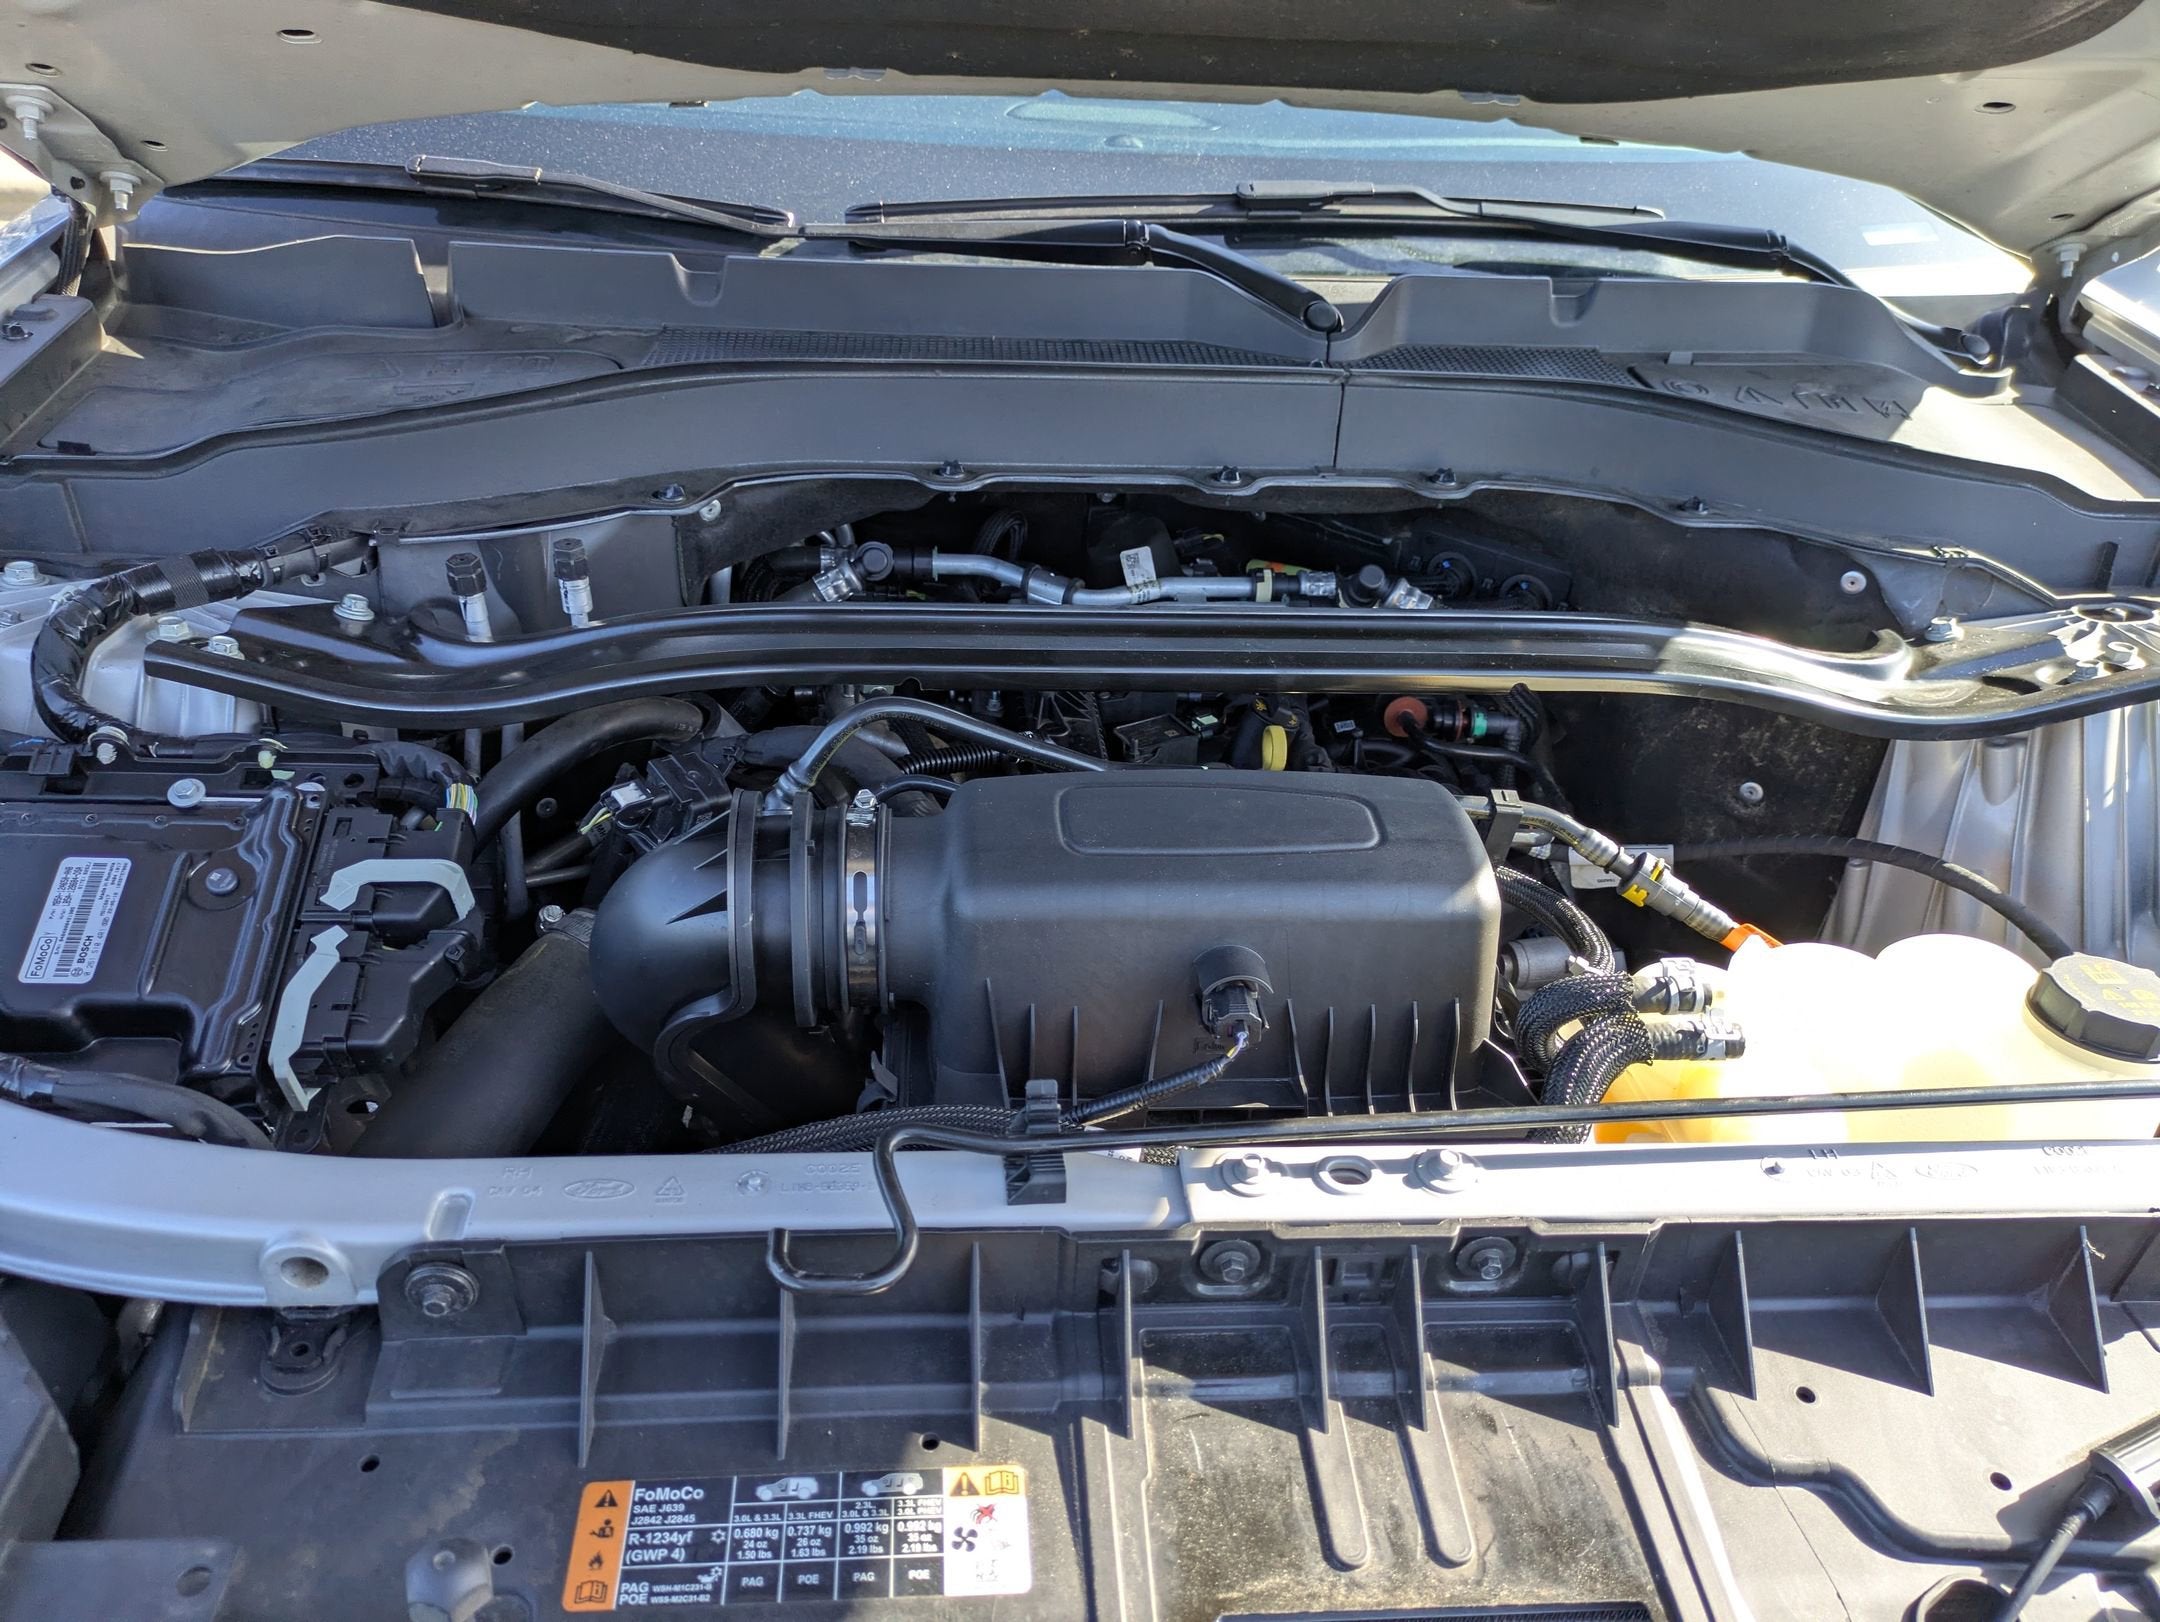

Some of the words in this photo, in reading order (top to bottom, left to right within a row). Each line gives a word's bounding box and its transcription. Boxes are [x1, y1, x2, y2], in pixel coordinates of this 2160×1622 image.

[99, 888, 107, 900] Made
[77, 935, 94, 963] BOSCH
[31, 938, 53, 976] FoMoCo
[635, 1486, 704, 1501] FoMoCo
[633, 1504, 656, 1513] SAE
[659, 1503, 685, 1513] J639
[734, 1514, 752, 1522] 3.0L
[788, 1512, 806, 1520] 3.3L
[808, 1511, 834, 1519] FHEV
[842, 1510, 860, 1518] 3.0L
[631, 1516, 662, 1525] J2842
[664, 1514, 696, 1524] J2845
[734, 1528, 763, 1539] 0.680
[765, 1527, 779, 1539] kg
[787, 1526, 815, 1536] 0.737
[818, 1525, 832, 1537] kg
[844, 1523, 873, 1533] 0.992
[875, 1522, 889, 1534] kg
[628, 1530, 693, 1545] R-1234yf
[796, 1538, 808, 1547] 26
[854, 1535, 865, 1543] 35
[867, 1535, 879, 1543] oz
[743, 1540, 754, 1549] 24
[848, 1545, 867, 1554] 2.19
[869, 1544, 884, 1553] lbs
[626, 1549, 668, 1564] (GWP
[670, 1548, 685, 1561] 4)
[737, 1551, 756, 1559] 1.50
[758, 1550, 772, 1559] lbs
[791, 1548, 810, 1557] 1.63
[811, 1548, 826, 1556] lbs
[798, 1574, 819, 1584] POE
[853, 1572, 875, 1582] PAG
[908, 1569, 930, 1580] POE
[741, 1576, 764, 1586] PAG
[621, 1582, 649, 1593] PAG
[619, 1593, 648, 1605] POE
